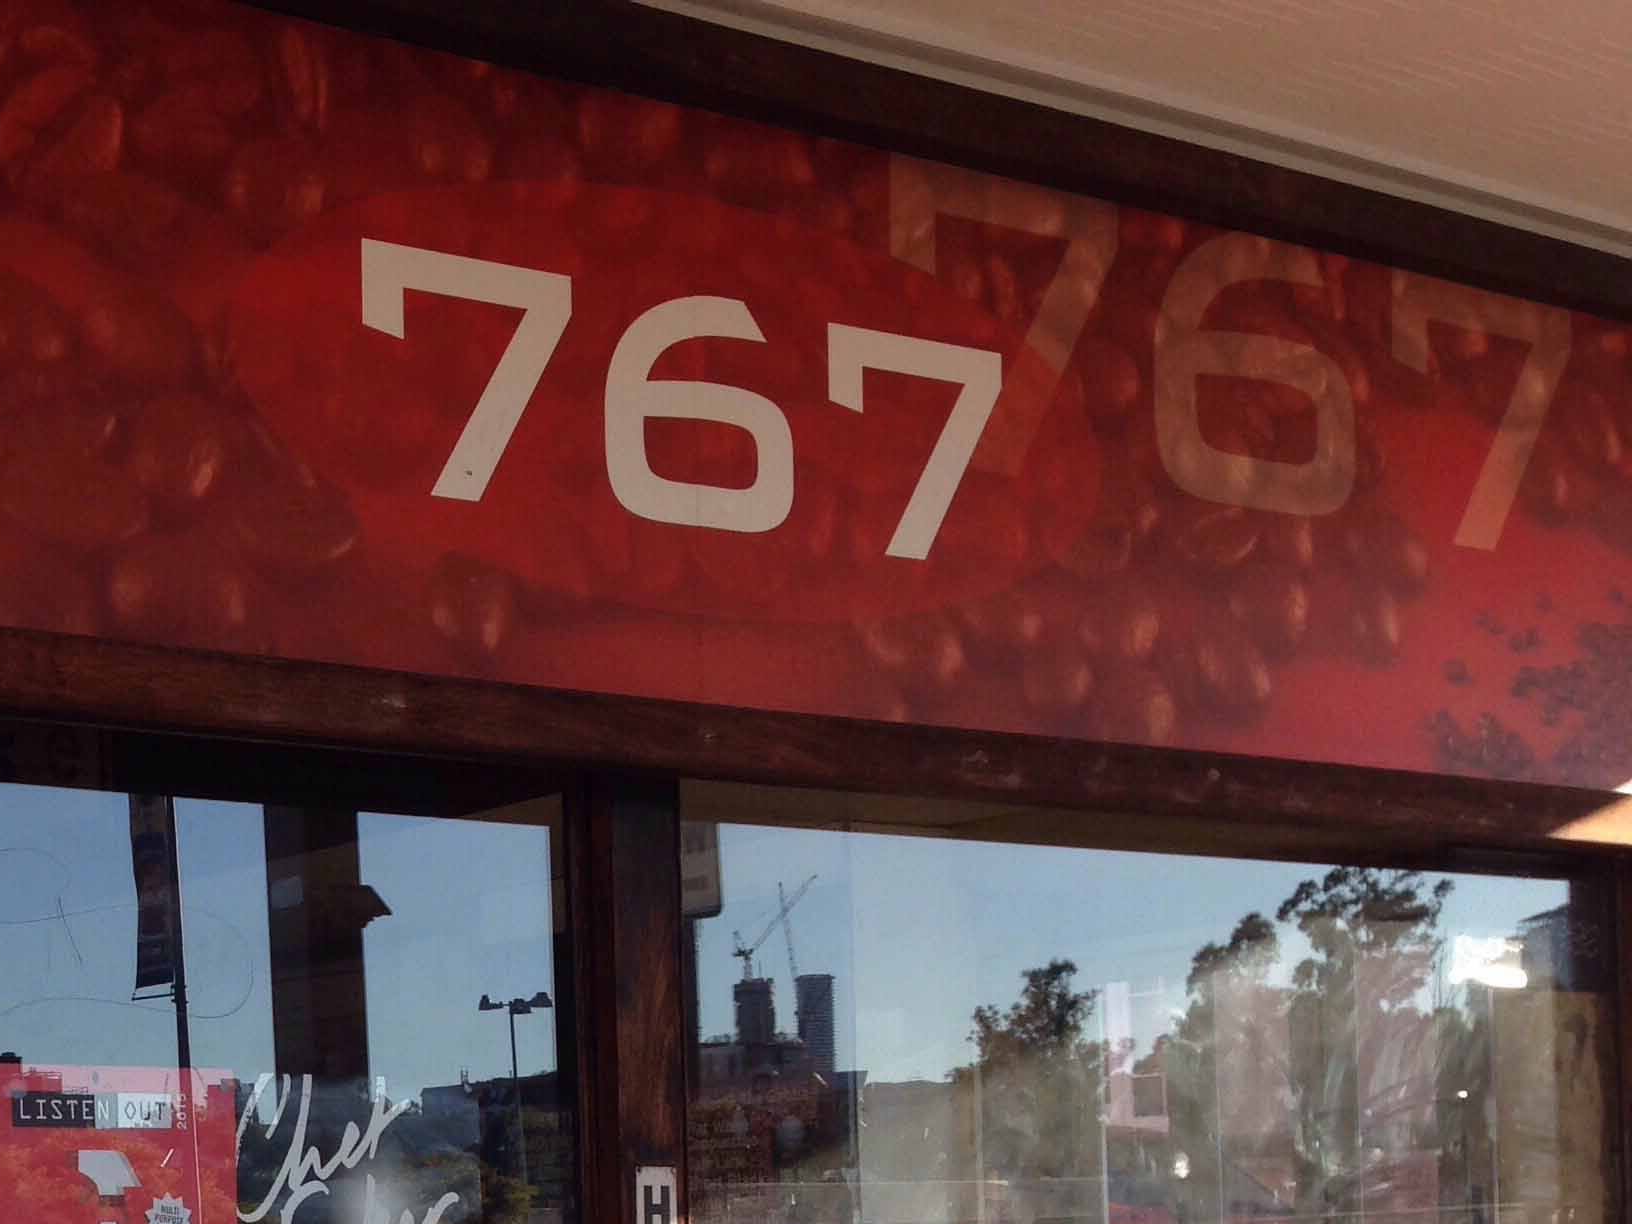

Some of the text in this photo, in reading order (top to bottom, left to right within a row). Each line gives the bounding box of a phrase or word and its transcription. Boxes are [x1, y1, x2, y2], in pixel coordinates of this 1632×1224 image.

[361, 237, 1003, 560] 767
[20, 1099, 166, 1121] LISTEN OUT
[236, 1072, 422, 1224] Chet
